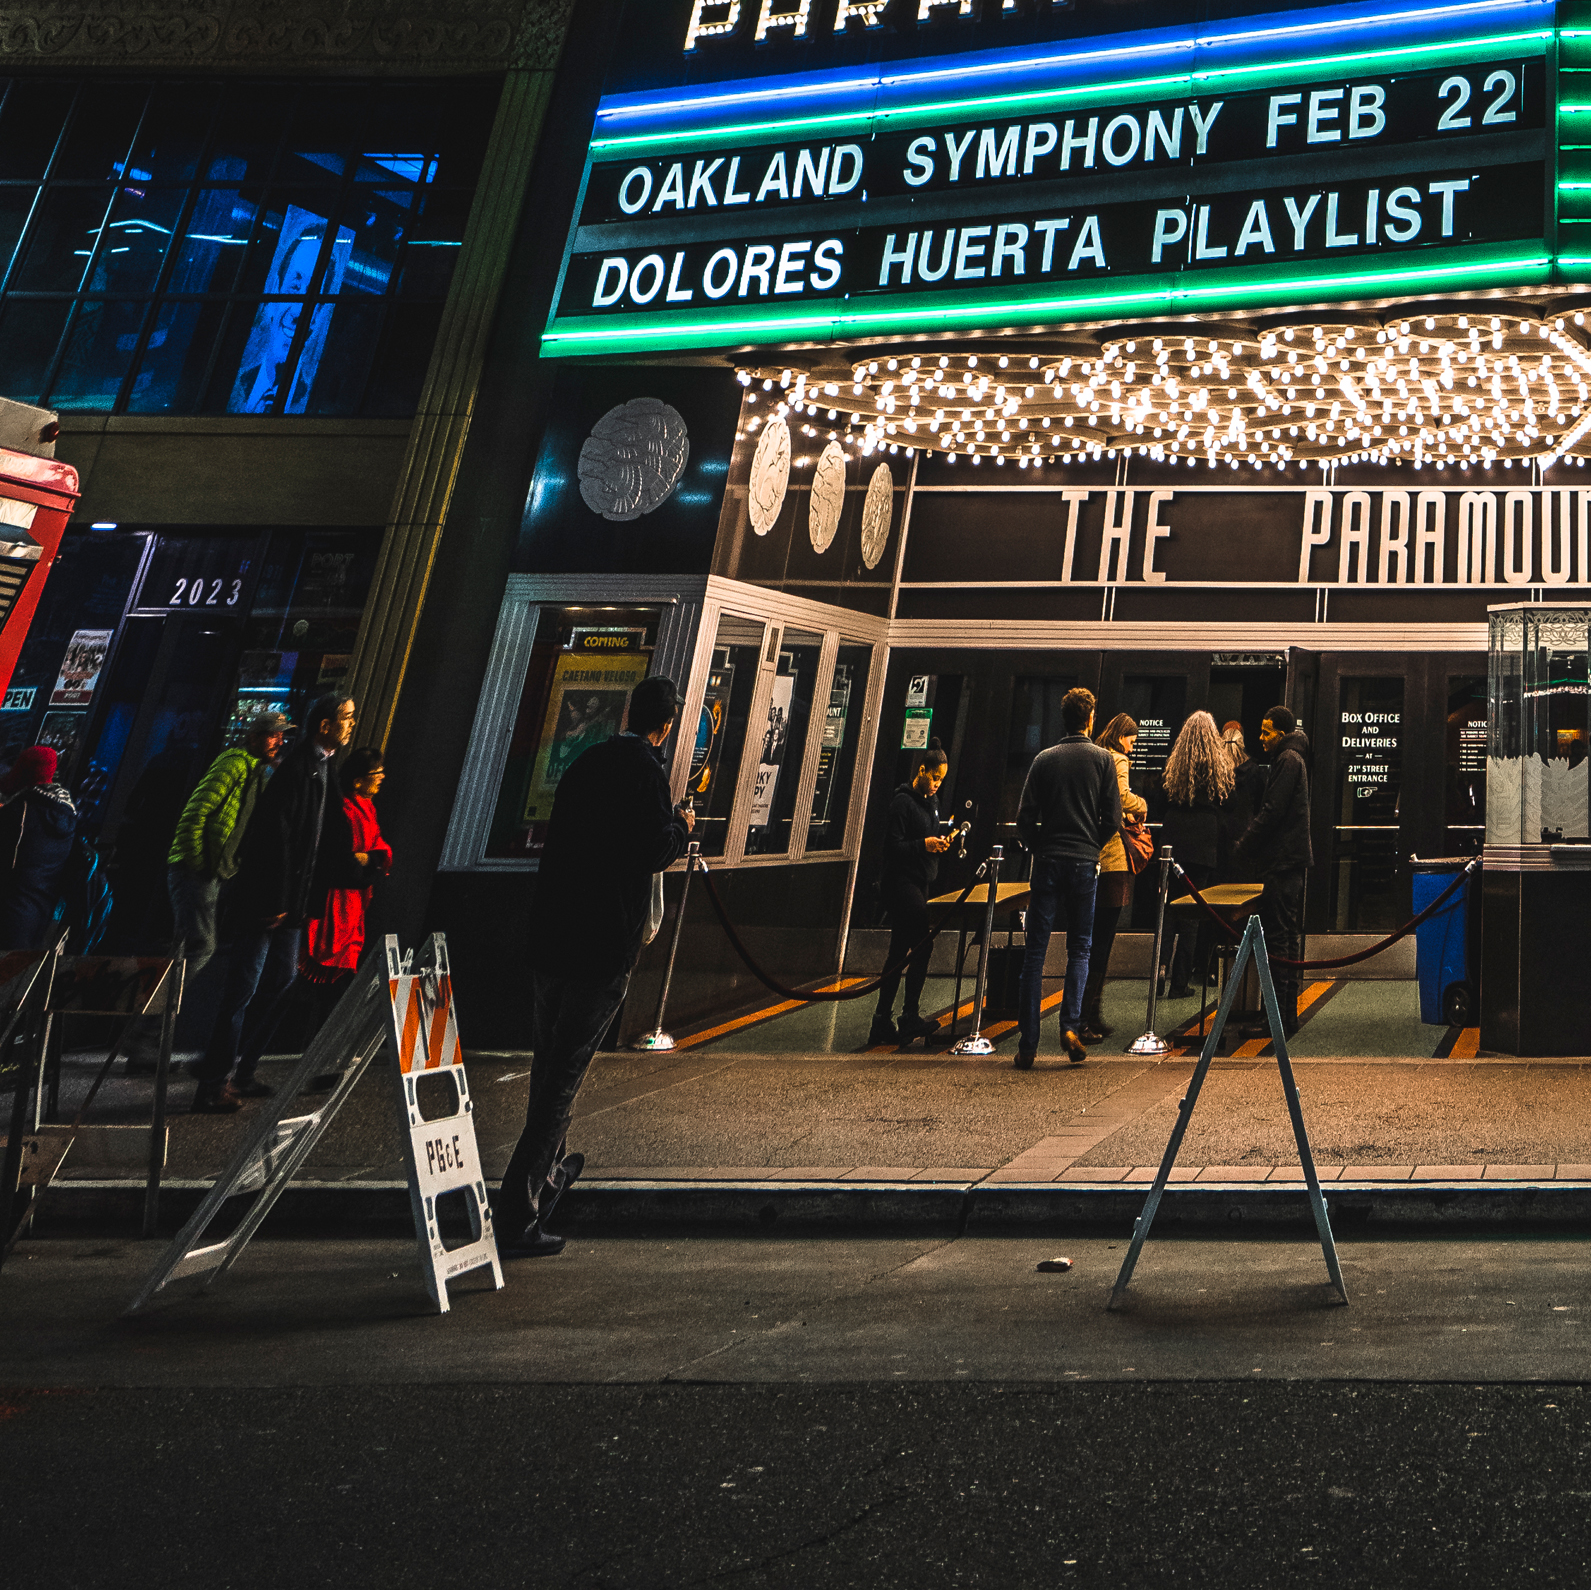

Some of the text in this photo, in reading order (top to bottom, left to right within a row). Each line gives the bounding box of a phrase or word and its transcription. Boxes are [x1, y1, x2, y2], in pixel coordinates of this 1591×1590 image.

[618, 69, 1517, 214] OAKLAND SYMPHONY FEB 22
[593, 179, 1472, 308] DOLORES HUERTA PLAYLIST
[1061, 490, 1174, 583] THE
[169, 578, 243, 605] 2023
[584, 636, 630, 648] COMING
[562, 670, 637, 683] CAETANO VELOSO
[1, 690, 33, 708] PEN
[1139, 719, 1163, 727] NOTICE
[1467, 720, 1487, 728] NOTIC
[1361, 726, 1379, 734] AND
[1362, 765, 1389, 773] STREET
[1348, 775, 1388, 783] ENTRANCE
